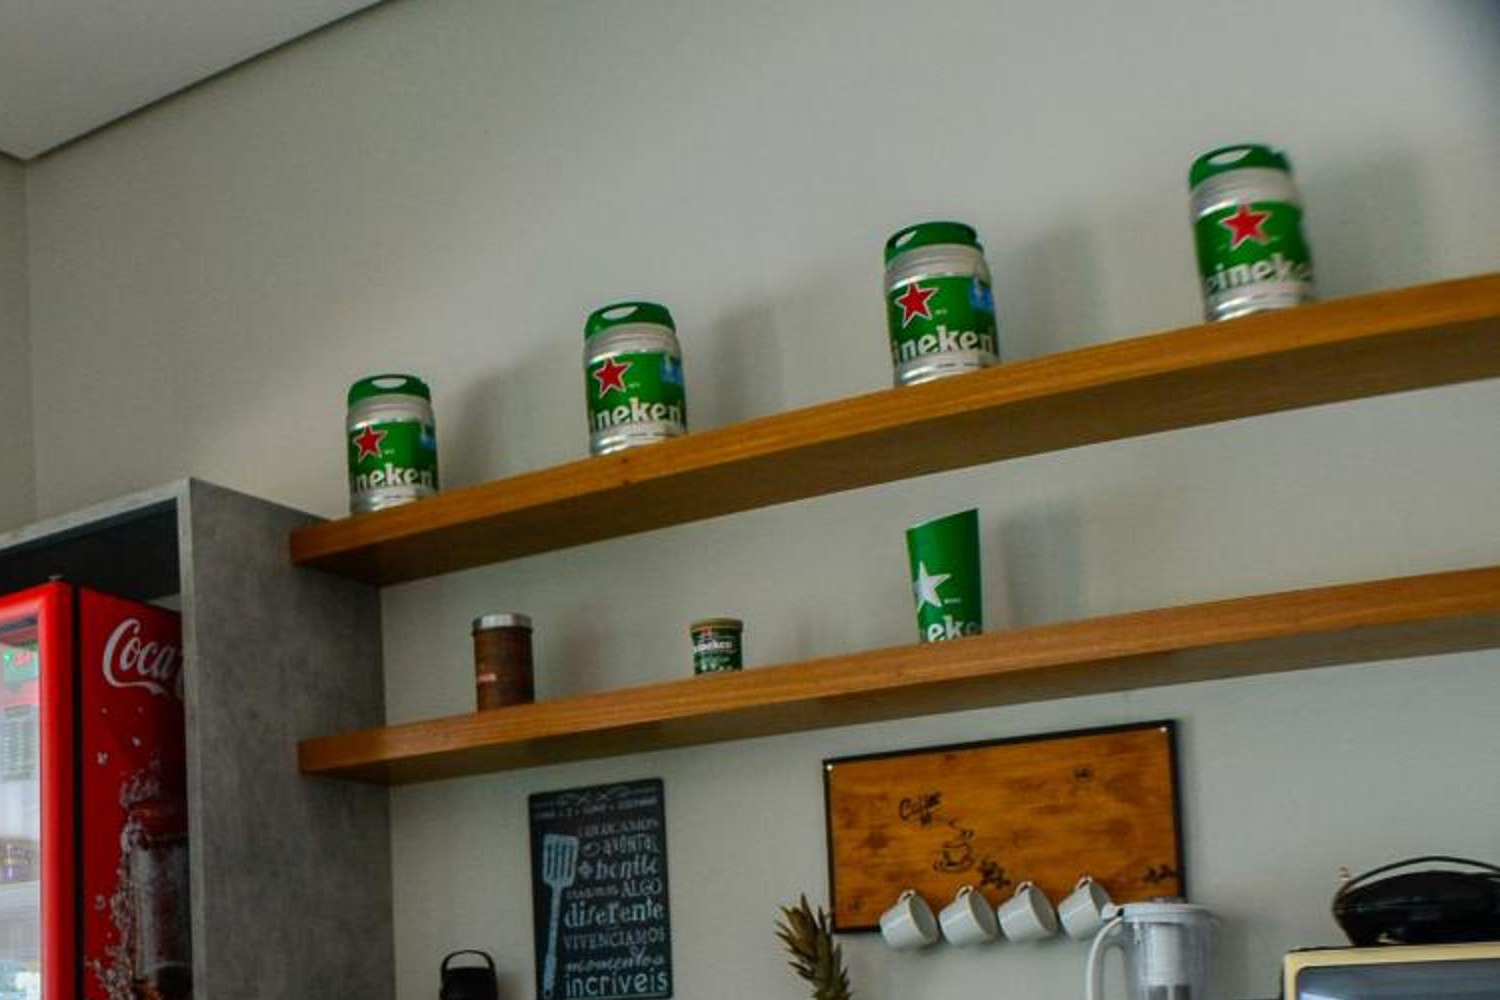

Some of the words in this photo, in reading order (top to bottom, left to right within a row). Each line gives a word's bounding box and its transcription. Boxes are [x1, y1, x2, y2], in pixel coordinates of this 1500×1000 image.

[893, 325, 994, 361] neken
[592, 397, 680, 430] neken
[354, 462, 433, 493] neken
